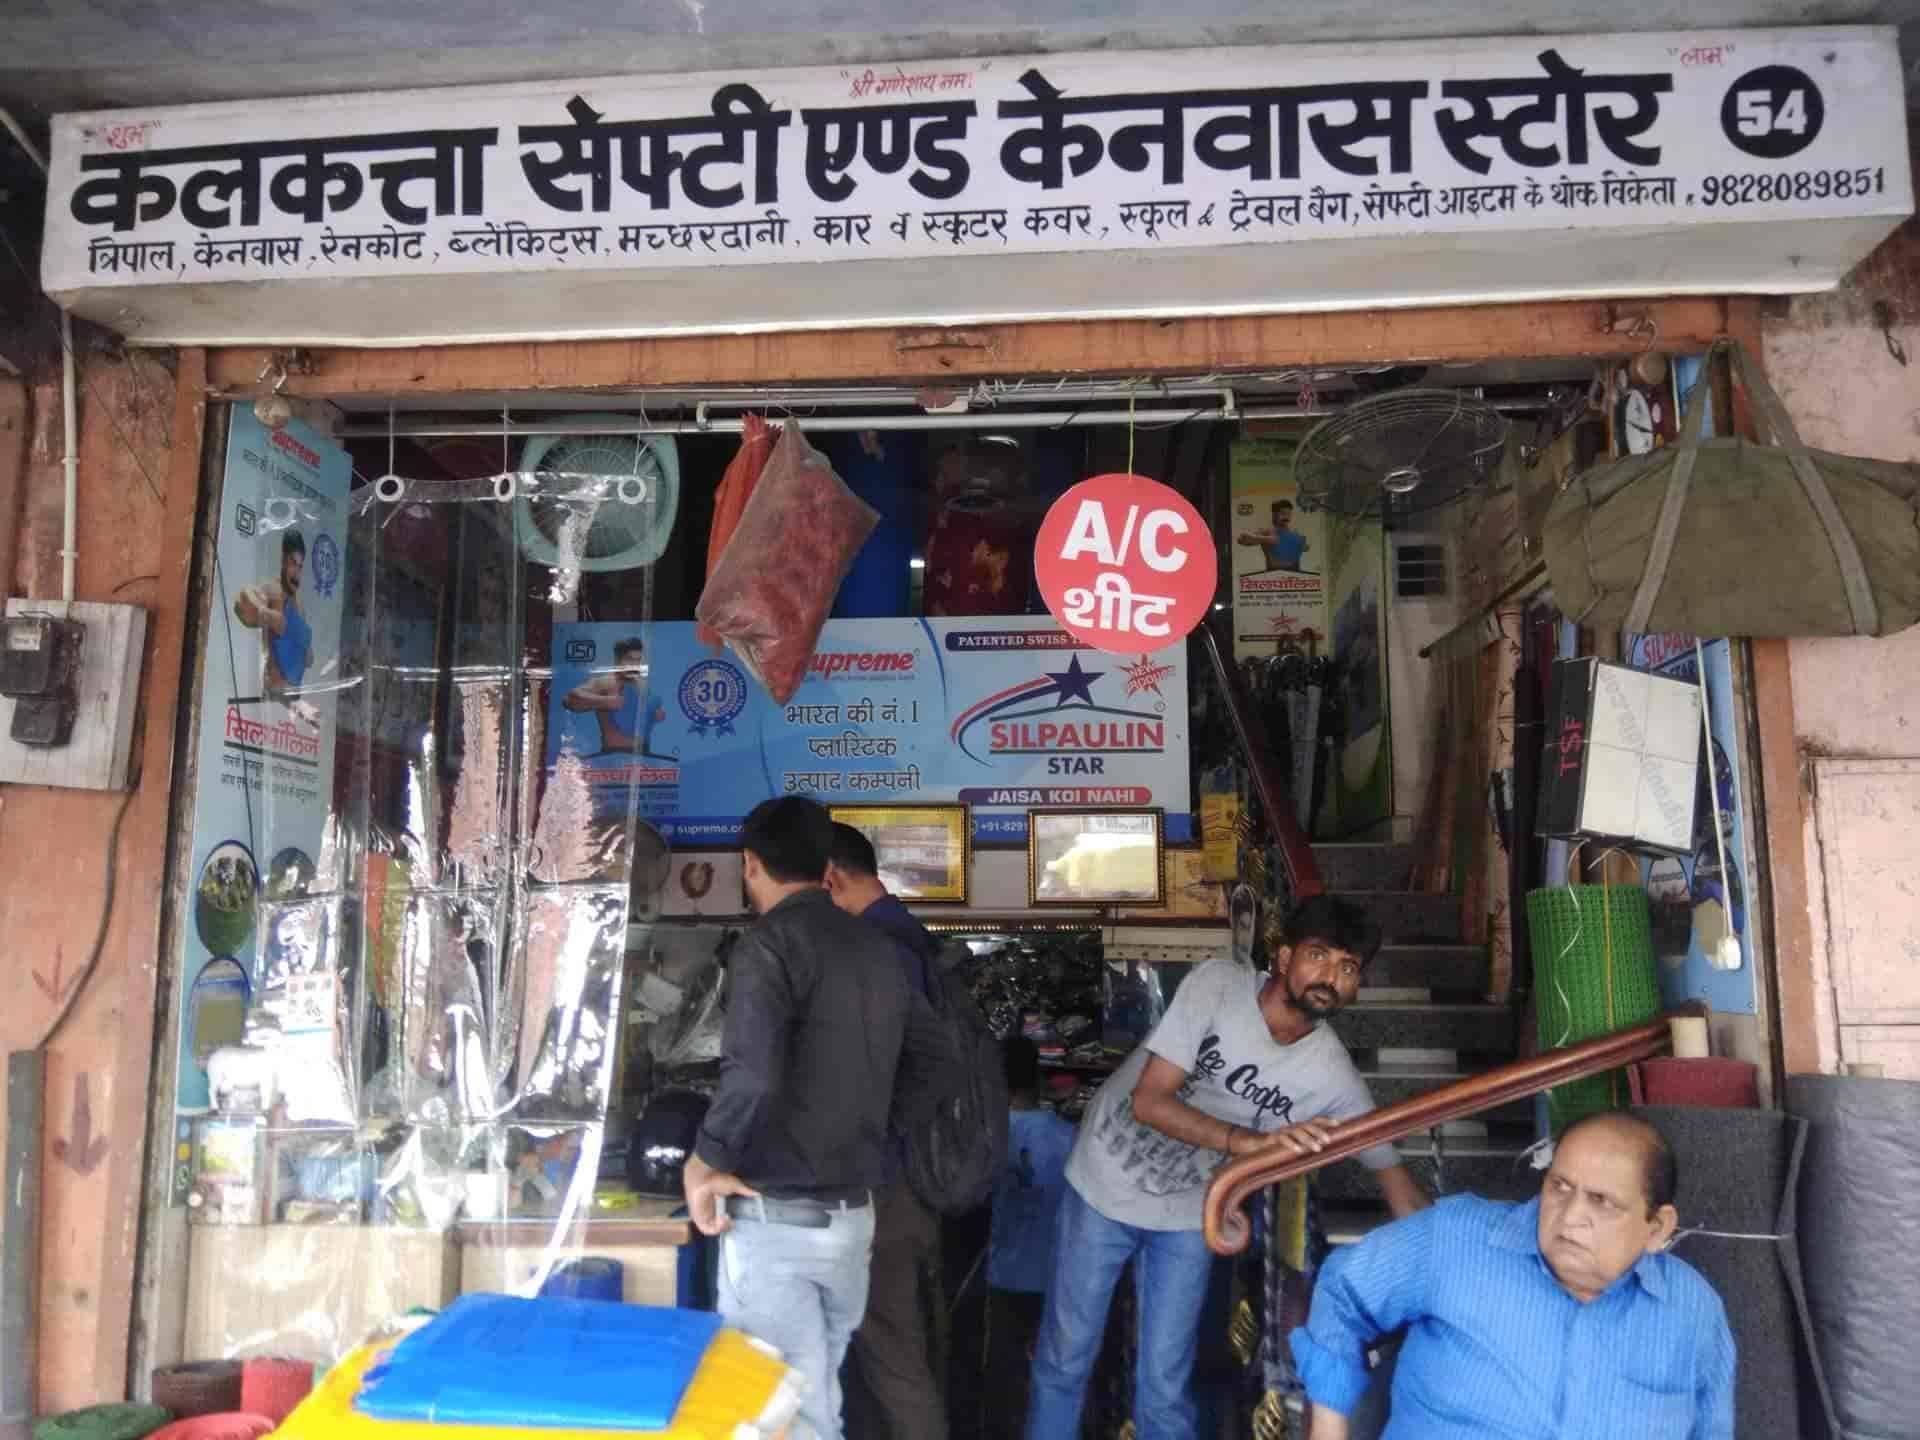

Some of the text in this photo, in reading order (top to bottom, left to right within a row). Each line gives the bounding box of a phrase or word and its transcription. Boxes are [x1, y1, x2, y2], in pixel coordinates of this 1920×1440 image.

[1736, 89, 1807, 137] 54
[70, 48, 1673, 232] कलकत्ता सेफ्टी एण्ड केनवास स्टोर
[813, 214, 872, 245] कार
[890, 212, 911, 241] व
[922, 209, 1008, 246] स्कूटर
[1119, 200, 1190, 241] स्कूल
[1229, 189, 1302, 232] ट्रेवल
[1362, 181, 1432, 221] सेफ्टी
[1435, 184, 1518, 218] आइटम
[1523, 176, 1545, 208] के
[1550, 174, 1599, 208] थोक
[1702, 167, 1885, 206] 9828089851
[1060, 499, 1189, 572] A/C
[1062, 572, 1176, 637] शीट
[958, 635, 1025, 647] PATENTED
[1025, 634, 1066, 646] SWISS
[808, 651, 913, 681] upreme
[698, 681, 727, 702] 30
[785, 703, 839, 724] भारत
[848, 697, 874, 724] की
[808, 730, 897, 757] प्लास्टिक
[991, 723, 1164, 749] SILPAULIN
[784, 764, 920, 793] उत्पाद कम्पनी
[1047, 757, 1104, 775] STAR
[987, 788, 1136, 804] JAISA KOI NAHI
[1224, 1063, 1295, 1123] Cooper
